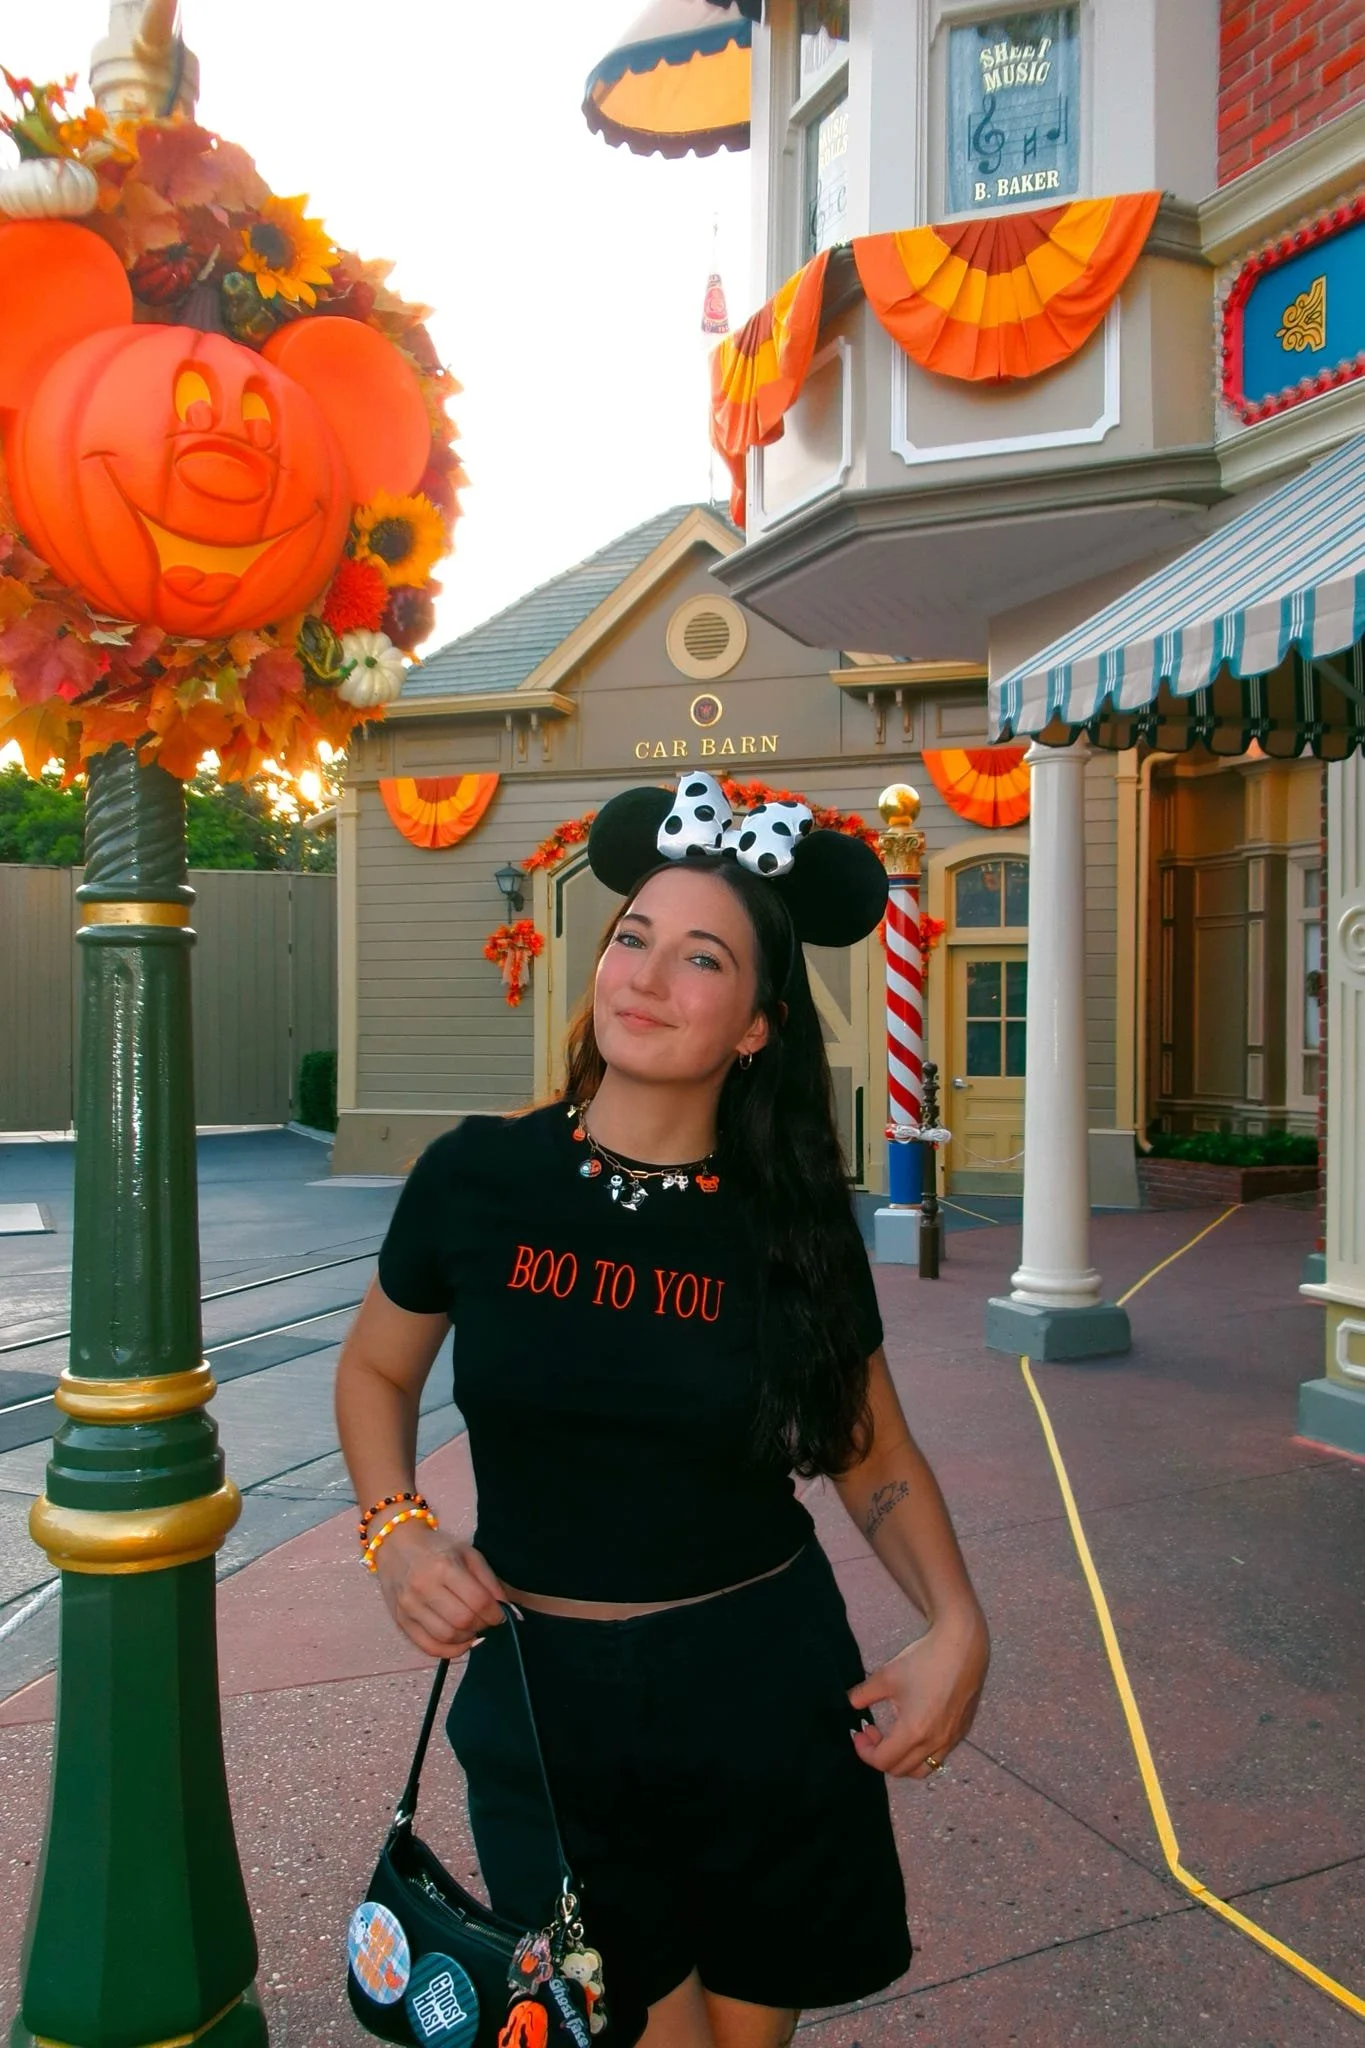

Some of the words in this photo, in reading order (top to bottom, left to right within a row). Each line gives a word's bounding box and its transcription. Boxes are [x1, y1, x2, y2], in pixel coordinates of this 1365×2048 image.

[979, 36, 1052, 71] SHEET
[982, 60, 1051, 94] MUSIC
[974, 182, 991, 201] B.
[997, 170, 1060, 197] BAKER
[635, 740, 688, 759] CAR
[701, 735, 779, 755] BARN
[507, 1245, 578, 1298] BOO
[592, 1260, 636, 1309] TO
[653, 1268, 726, 1321] YOU
